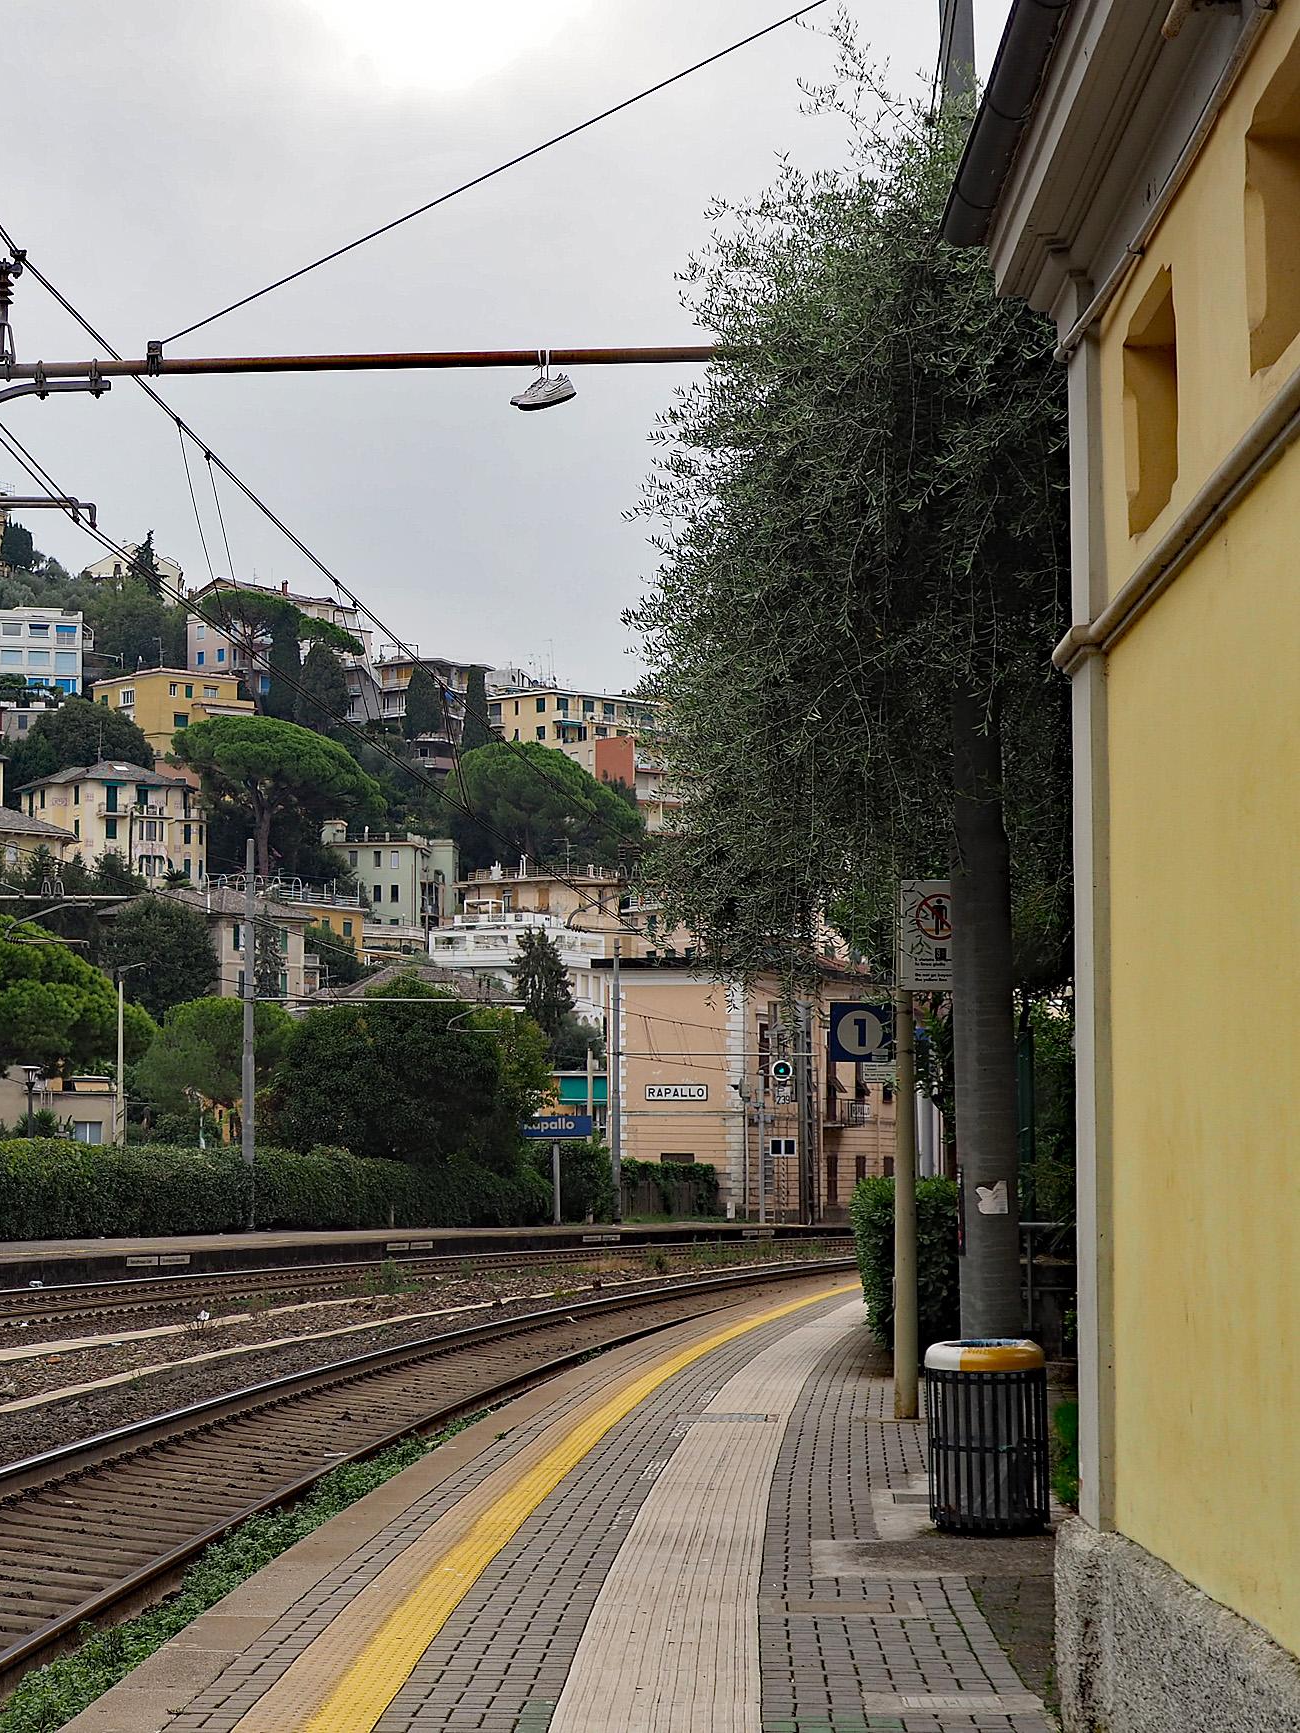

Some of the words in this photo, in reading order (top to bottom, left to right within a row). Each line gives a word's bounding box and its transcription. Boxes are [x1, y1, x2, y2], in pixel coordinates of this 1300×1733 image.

[854, 1018, 867, 1047] 1
[647, 1087, 705, 1098] RAPALLO
[776, 1095, 791, 1105] 239
